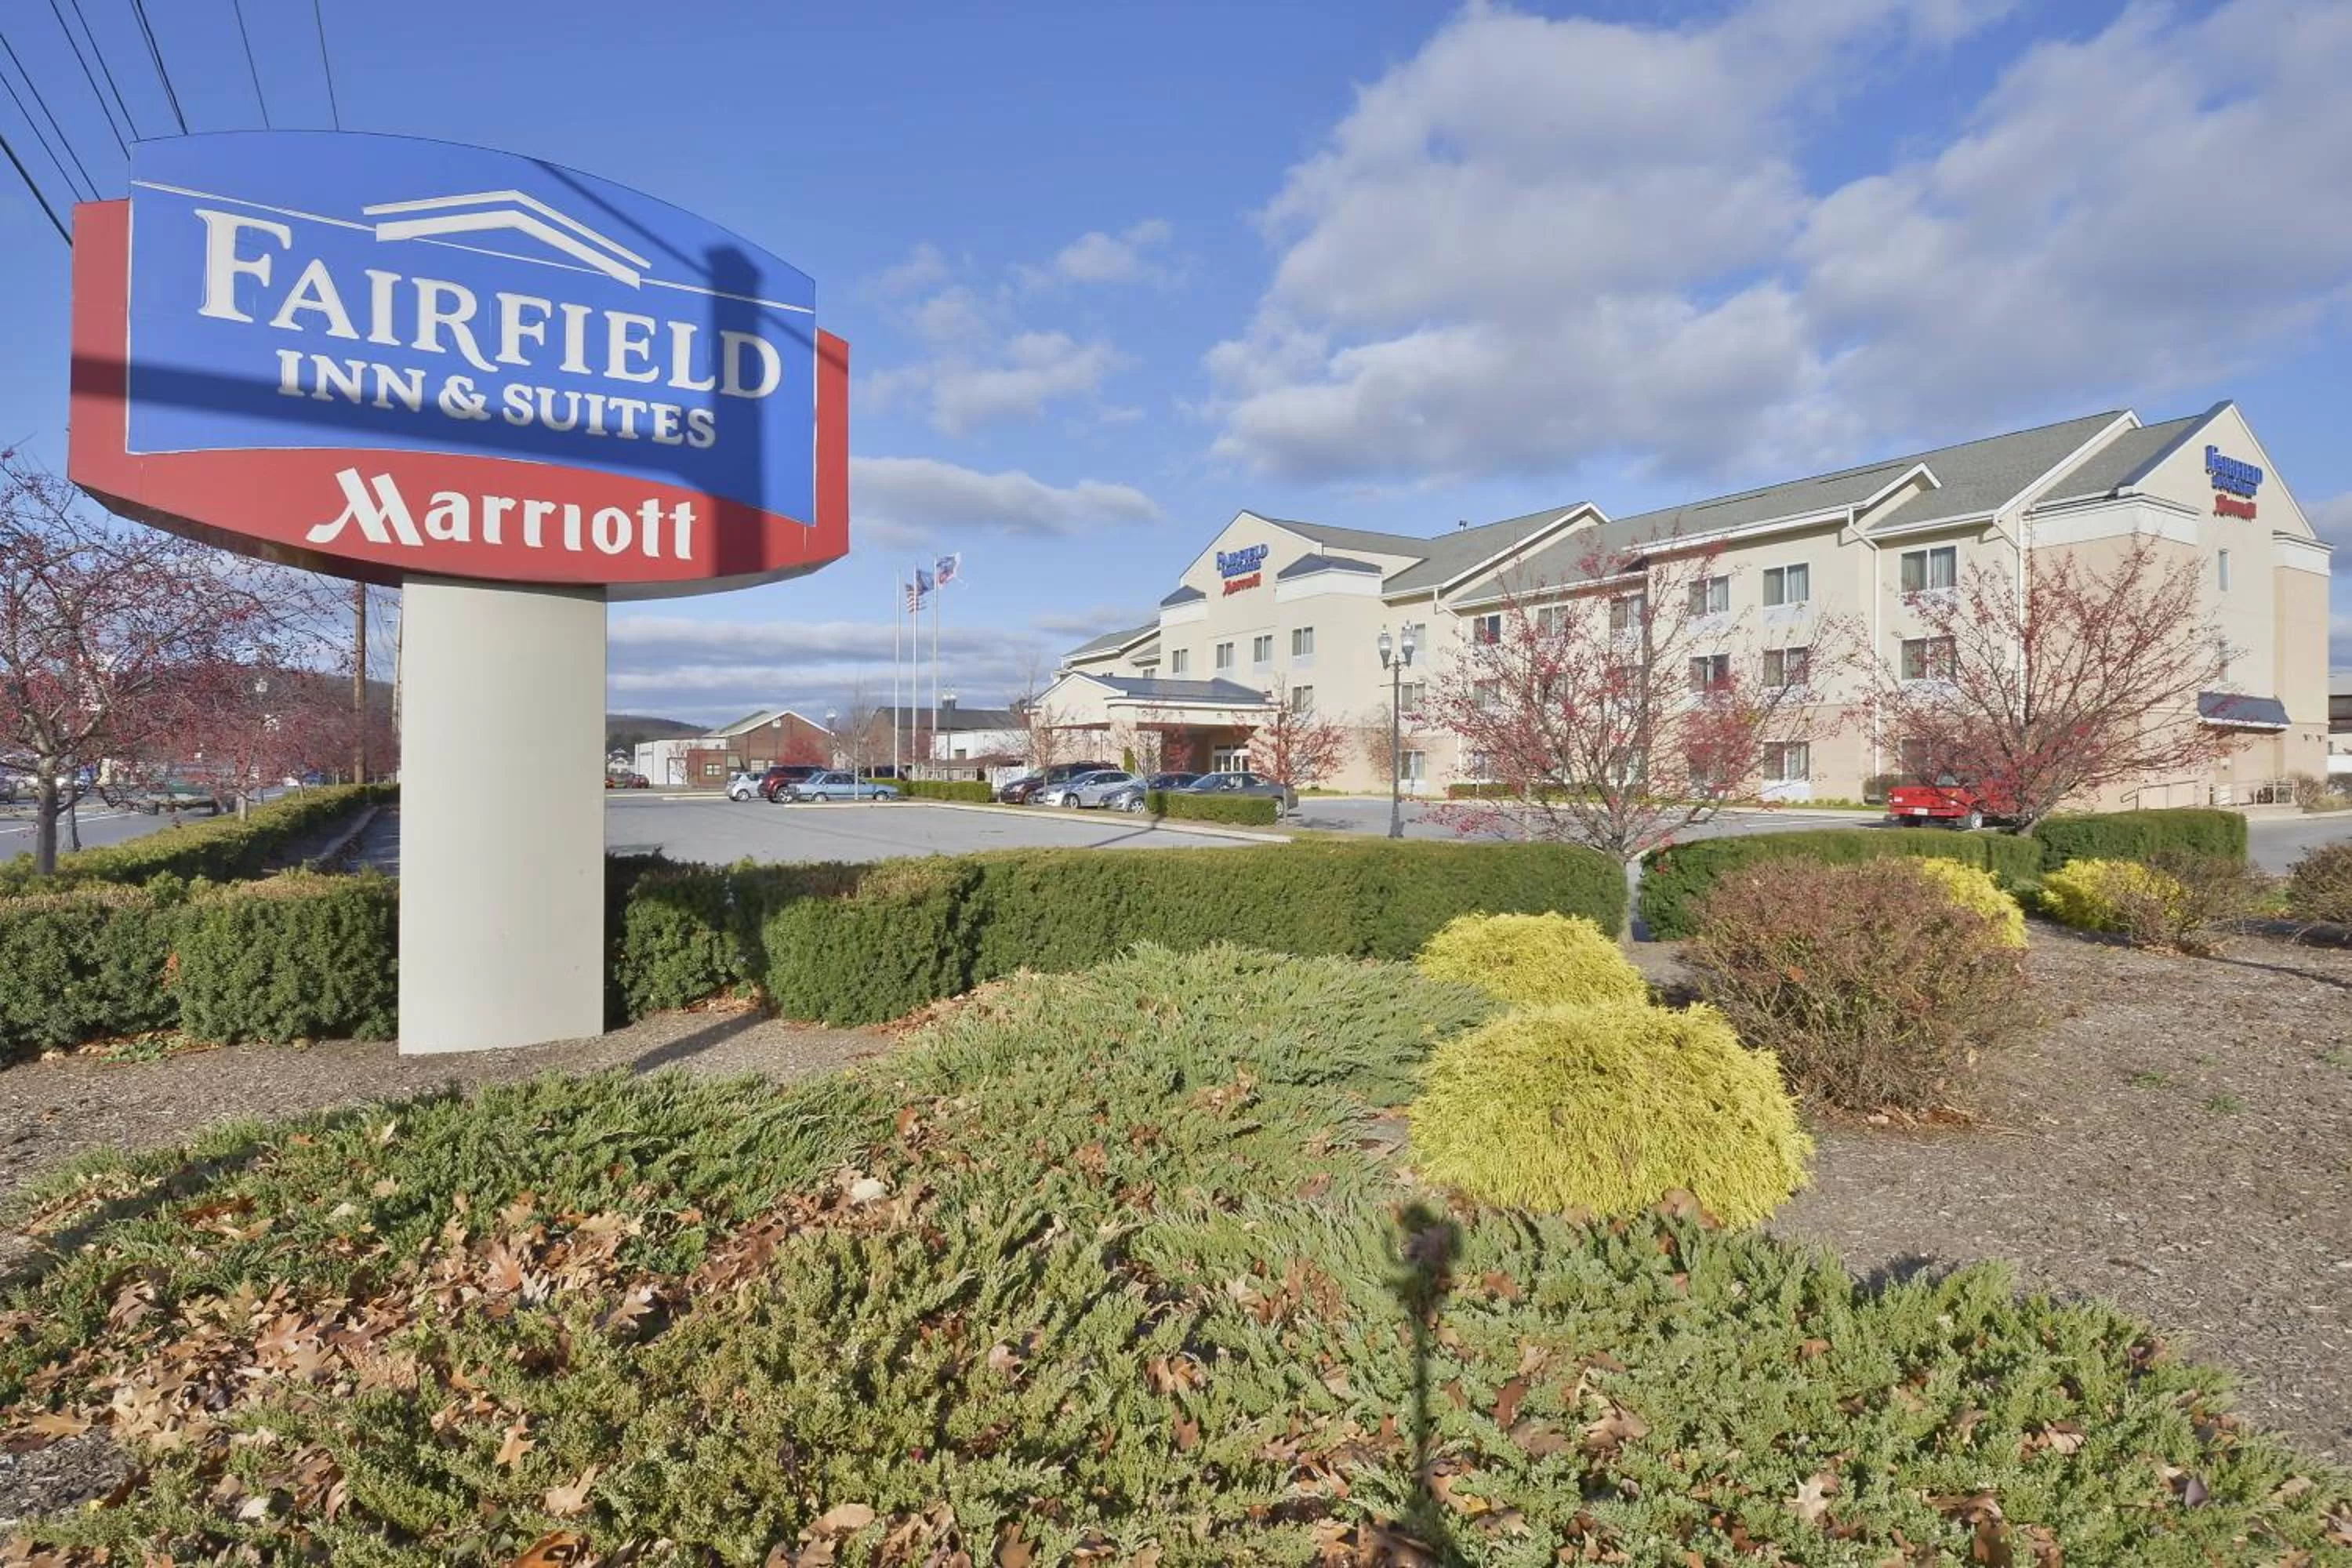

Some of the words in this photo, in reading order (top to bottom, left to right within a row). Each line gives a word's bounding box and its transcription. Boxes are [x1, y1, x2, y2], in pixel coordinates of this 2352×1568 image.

[194, 208, 782, 400] FAIRFIELD
[277, 350, 426, 411] INN
[438, 376, 490, 421] &
[503, 383, 715, 448] SUITES
[306, 467, 695, 560] Marriott
